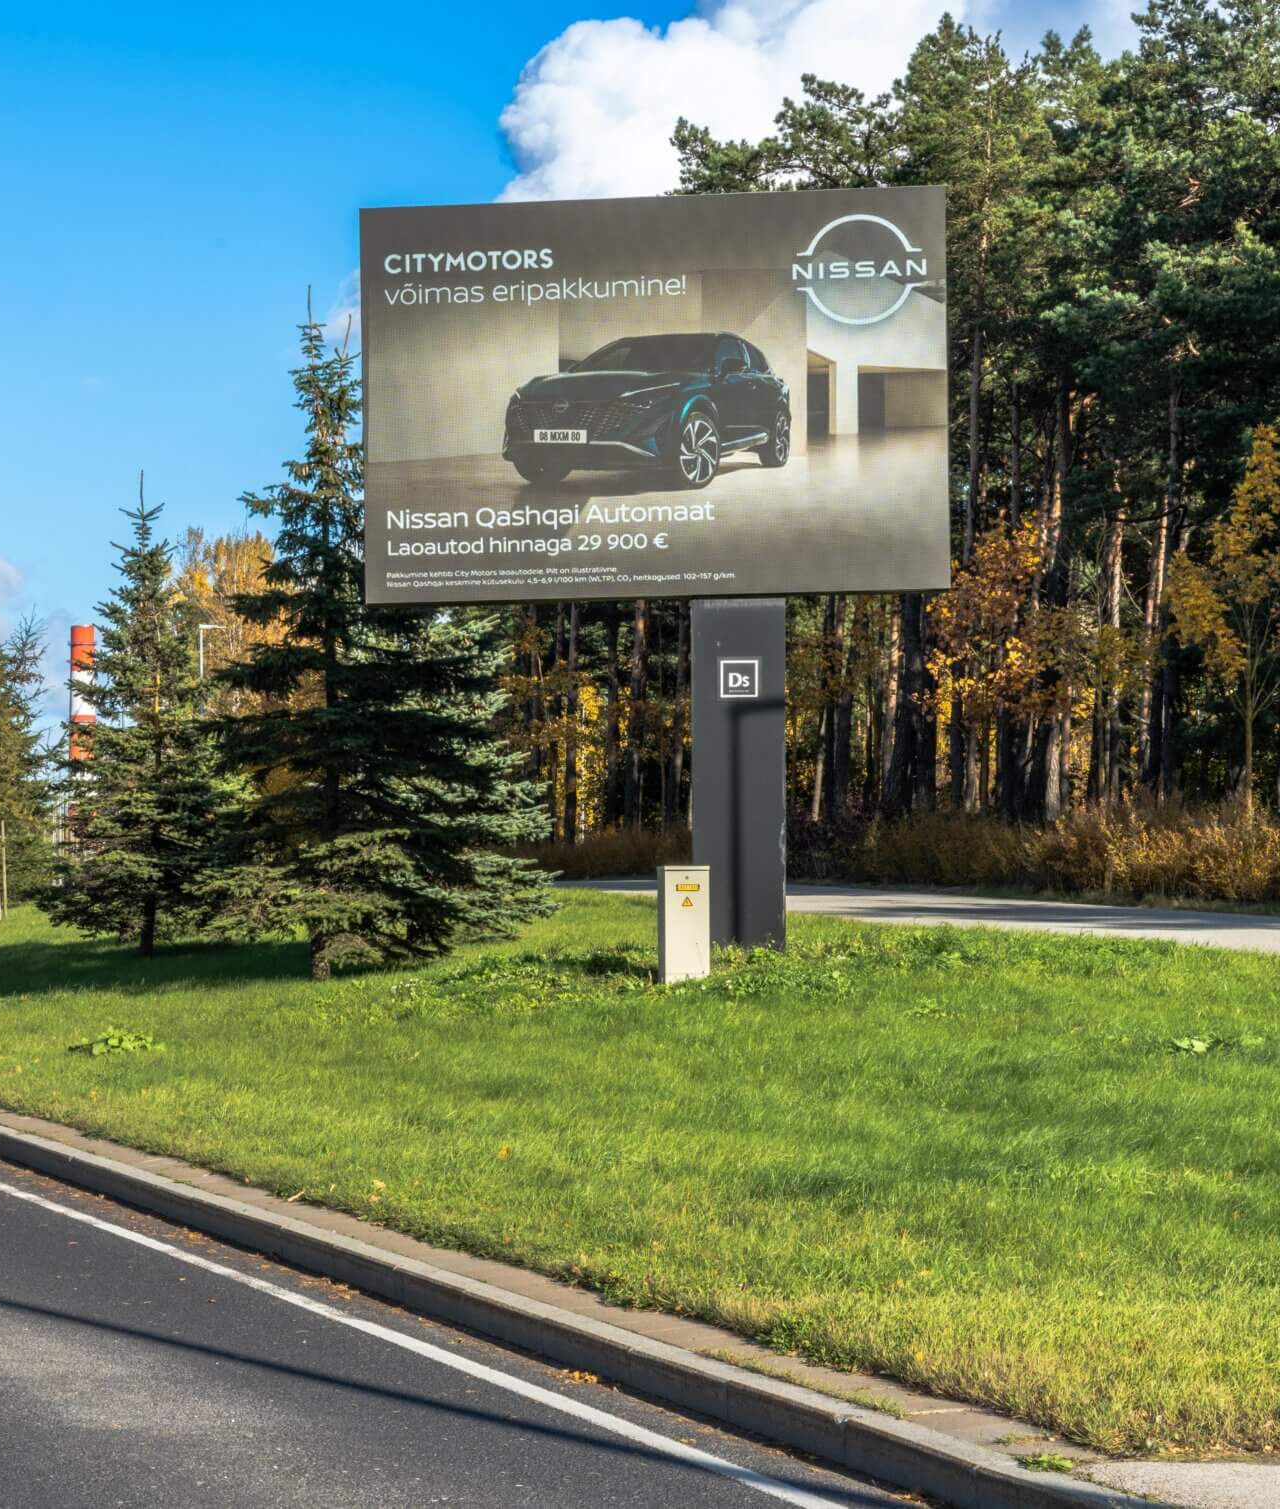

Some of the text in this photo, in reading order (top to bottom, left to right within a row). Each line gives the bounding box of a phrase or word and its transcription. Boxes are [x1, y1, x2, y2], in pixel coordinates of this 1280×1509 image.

[384, 248, 554, 274] CITYMOTORS
[792, 258, 927, 281] NISSAN
[384, 275, 687, 306] võimas eripakkumine!
[550, 431, 569, 441] MXM
[386, 502, 716, 531] Nissan Qashqai Automaat
[387, 533, 669, 557] Laoautod hinnaga 29 900 €
[413, 580, 444, 588] Qashqai
[454, 569, 470, 579] City
[470, 569, 498, 577] Motors
[728, 672, 751, 688] Ds
